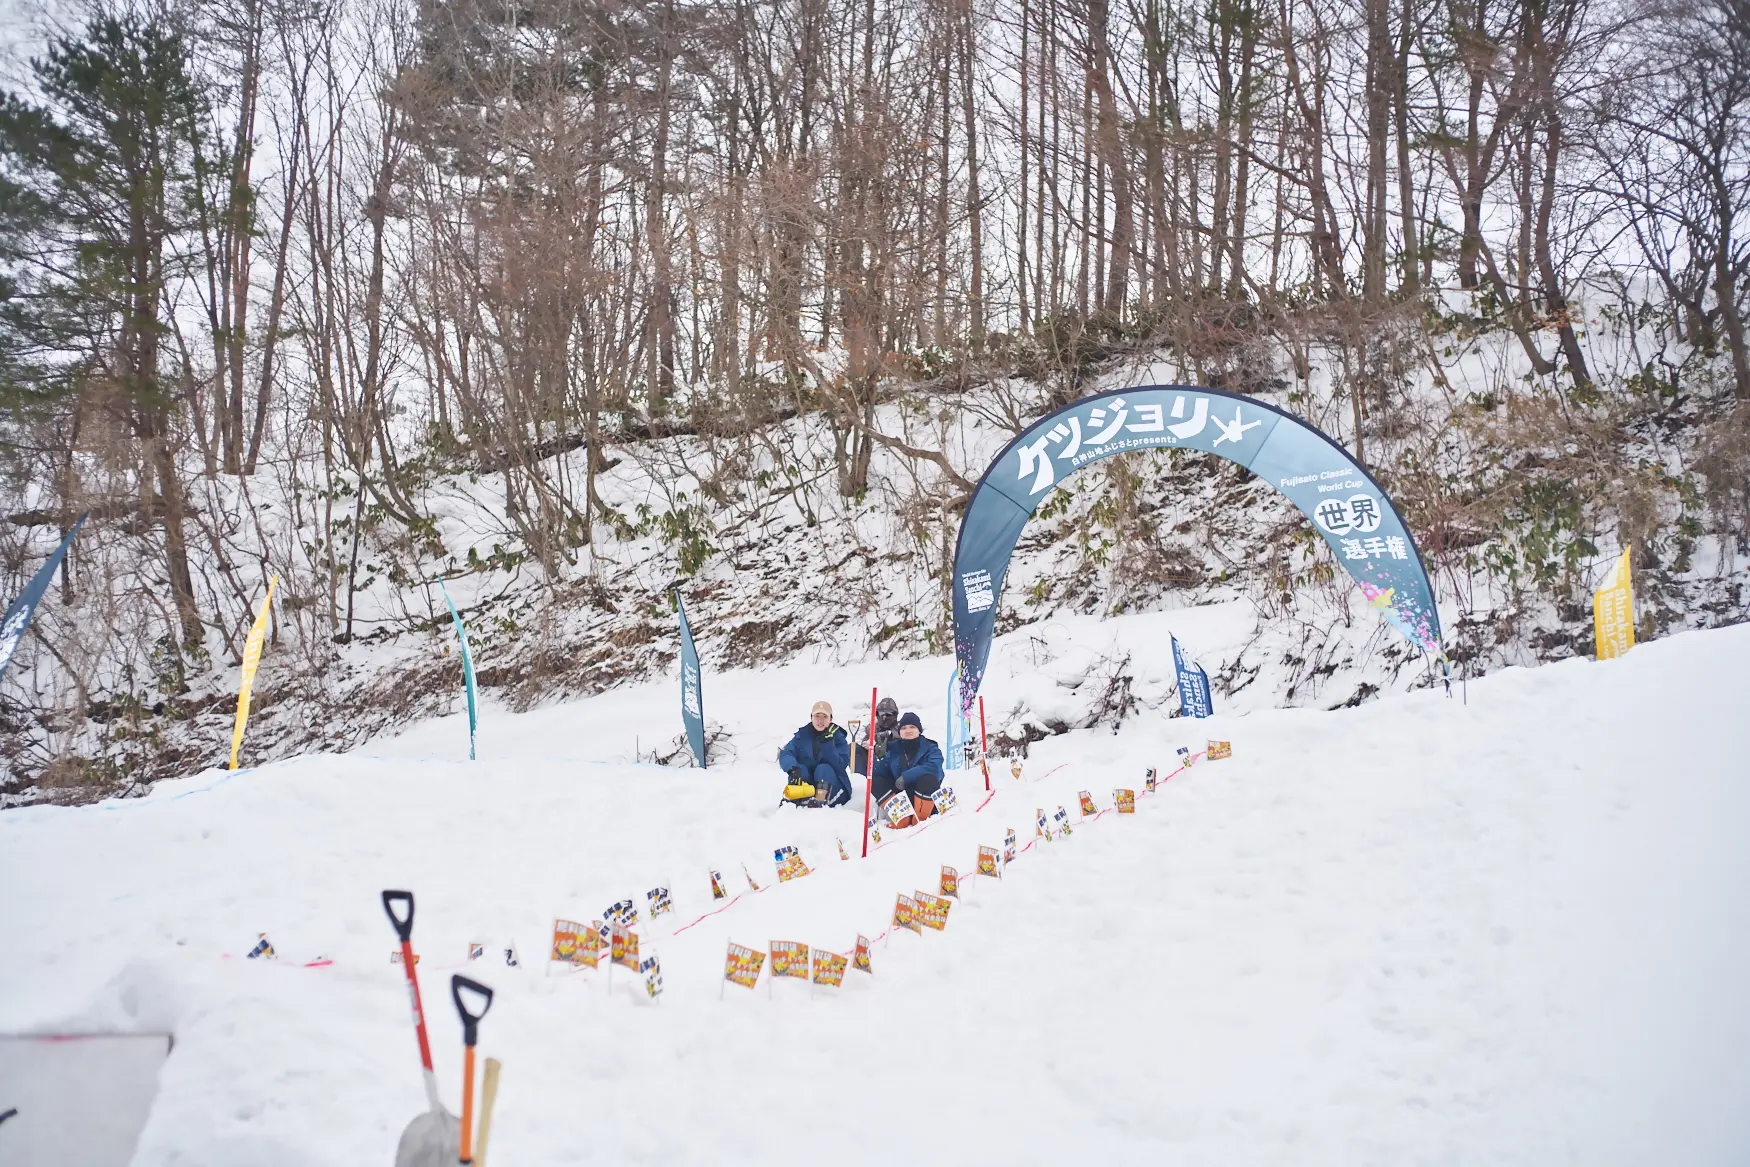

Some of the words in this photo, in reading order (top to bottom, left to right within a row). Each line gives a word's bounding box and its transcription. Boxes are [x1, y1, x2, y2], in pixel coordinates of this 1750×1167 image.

[1017, 396, 1210, 495] ケツジョリ
[1280, 473, 1318, 488] Fujisato
[1320, 467, 1353, 480] Classic
[1318, 482, 1343, 493] World
[1345, 480, 1364, 490] Cup
[1318, 499, 1378, 530] 世界
[1340, 535, 1408, 560] 選手権
